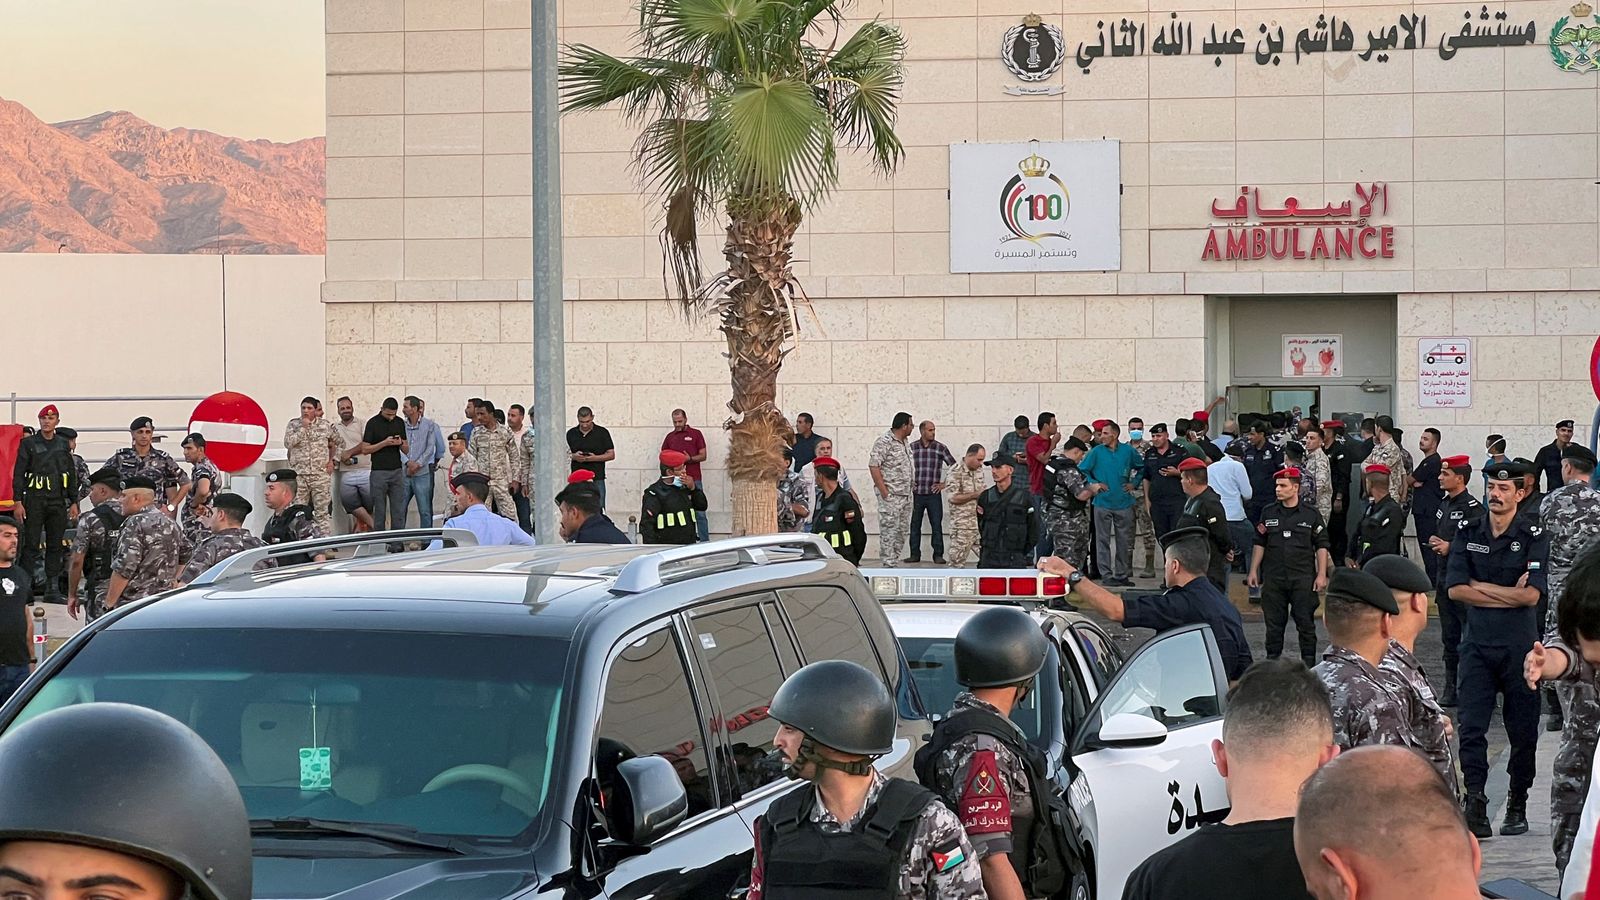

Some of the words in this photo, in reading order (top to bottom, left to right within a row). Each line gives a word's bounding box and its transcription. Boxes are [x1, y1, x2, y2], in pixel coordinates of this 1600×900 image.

[1152, 12, 1192, 56] الله
[1295, 14, 1354, 65] هاشم
[1438, 5, 1536, 61] مستشفى
[1076, 18, 1145, 75] الثاني
[1202, 22, 1245, 67] عبد
[1255, 23, 1284, 66] بن
[1025, 194, 1062, 221] 100
[1059, 230, 1072, 239] 2021
[1201, 227, 1395, 261] AMBULANCE
[994, 248, 1036, 260] المسيرة
[1038, 248, 1077, 259] وتستمر
[1438, 369, 1455, 378] مخصص
[1442, 379, 1455, 387] وقوف
[1455, 369, 1470, 378] مكان
[967, 801, 989, 814] السريع
[990, 801, 1002, 812] الرد
